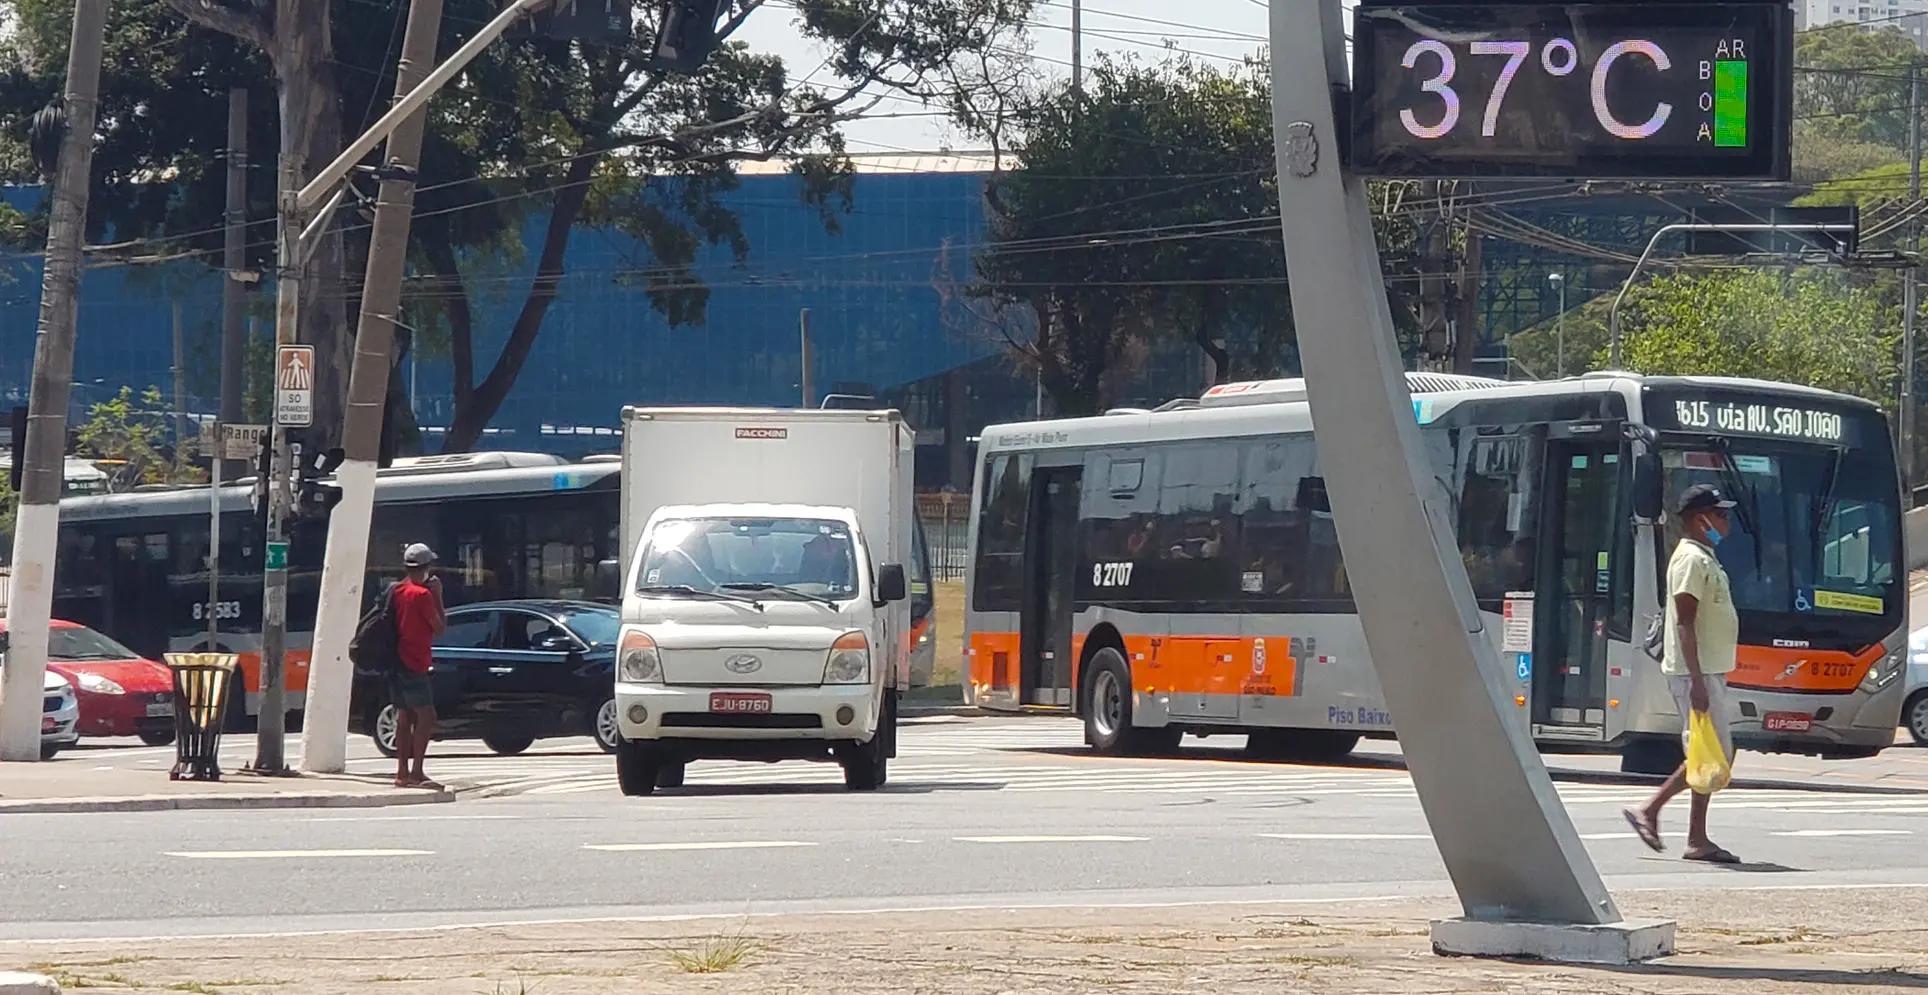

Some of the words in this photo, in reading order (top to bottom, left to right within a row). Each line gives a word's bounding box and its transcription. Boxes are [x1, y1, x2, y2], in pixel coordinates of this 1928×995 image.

[1716, 39, 1745, 58] AR
[1400, 38, 1673, 139] 37°C
[1717, 402, 1745, 431] via
[1773, 407, 1801, 436] SÃO
[1804, 410, 1841, 440] JOÃO
[1093, 562, 1102, 587] 8
[1102, 562, 1133, 587] 2707
[193, 602, 202, 620] 8
[1811, 662, 1820, 676] 8
[1823, 662, 1856, 677] 2707
[711, 698, 769, 711] EJU-8760
[1328, 704, 1354, 725] Piso
